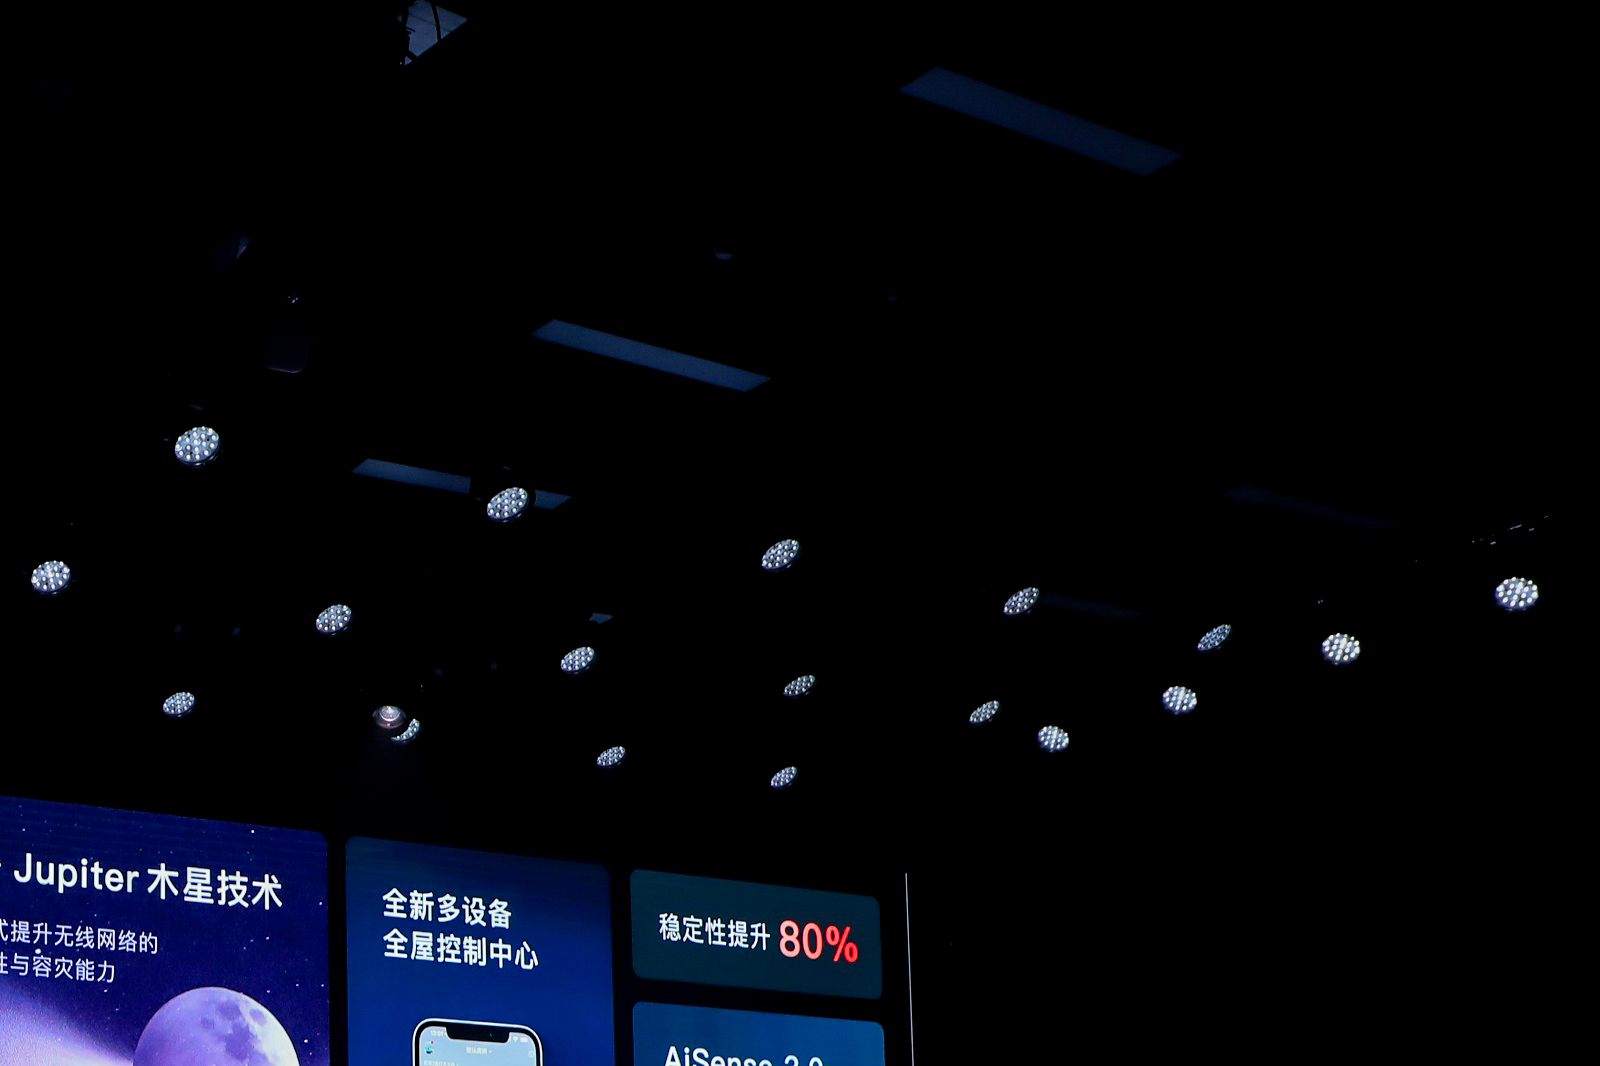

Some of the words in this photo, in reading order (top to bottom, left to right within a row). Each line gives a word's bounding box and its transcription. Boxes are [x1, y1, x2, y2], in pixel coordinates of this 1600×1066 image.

[12, 852, 140, 894] Jupiter
[146, 861, 284, 912] 木星技术
[382, 887, 512, 930] 全新多设备
[383, 927, 539, 970] 全屋控制中心
[659, 913, 770, 950] 稳定性提升
[780, 920, 858, 962] 80%
